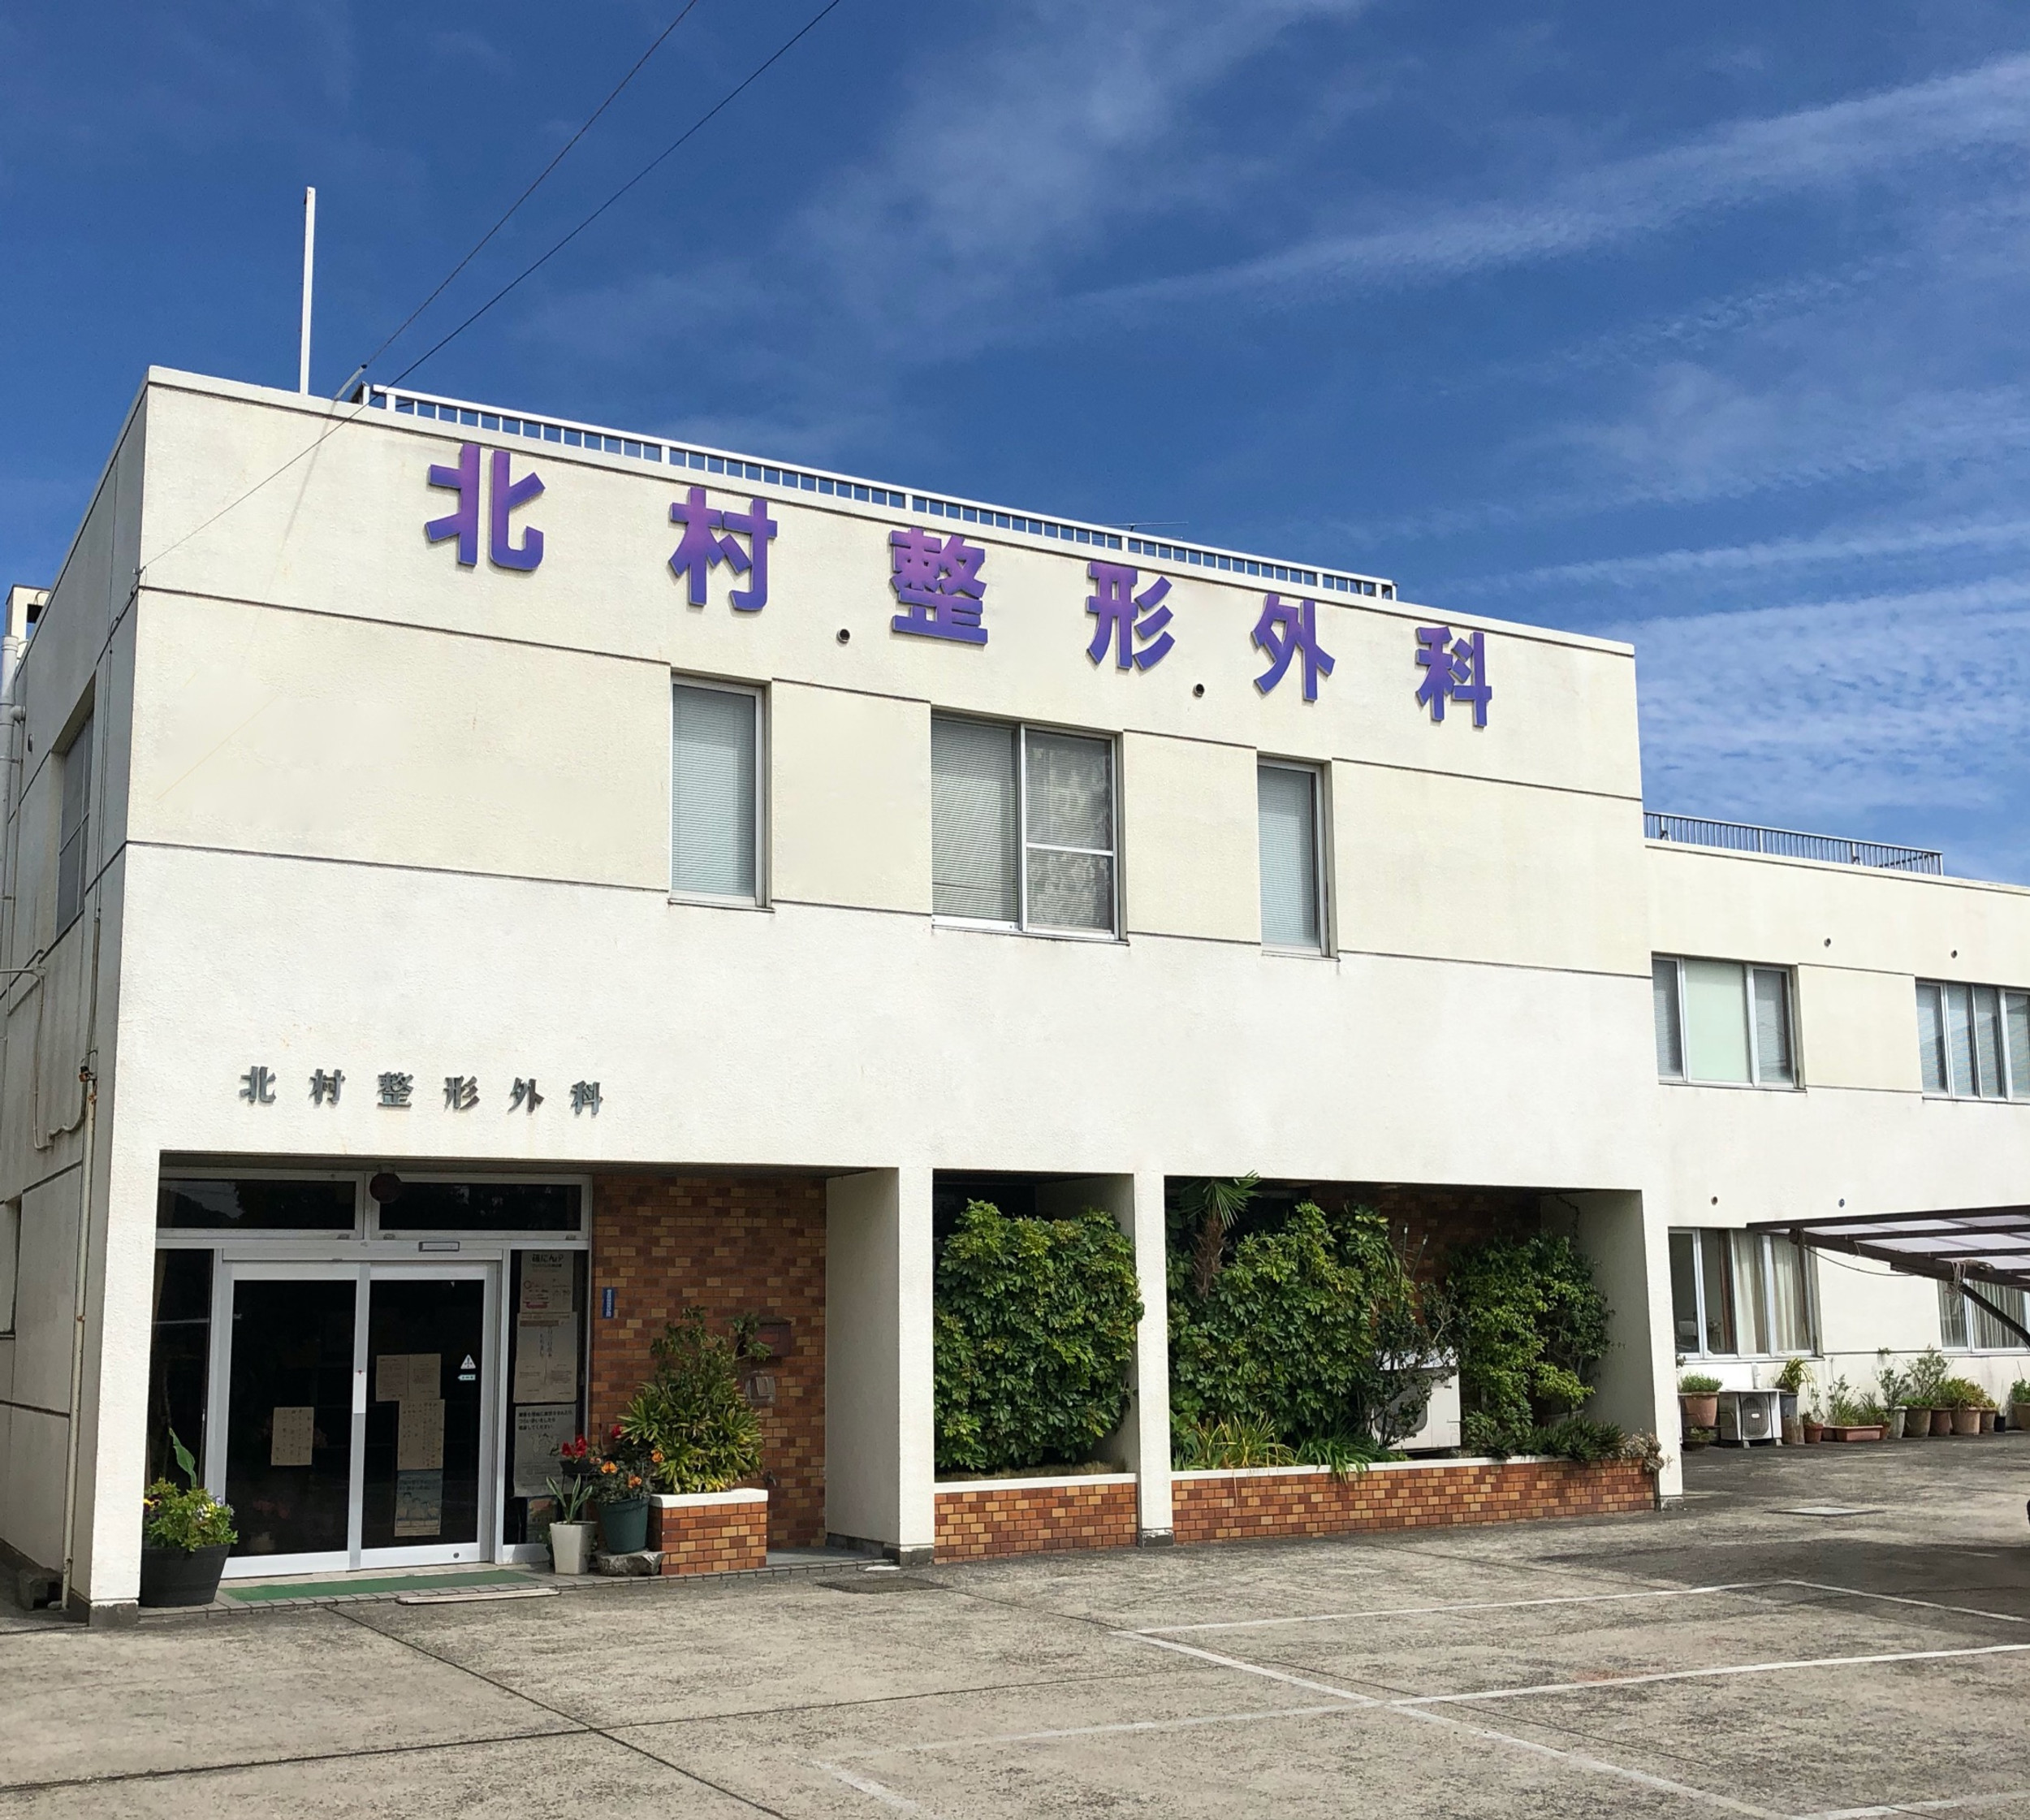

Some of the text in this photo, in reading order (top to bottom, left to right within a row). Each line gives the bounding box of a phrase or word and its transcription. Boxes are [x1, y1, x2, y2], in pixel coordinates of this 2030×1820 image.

[425, 442, 1492, 728] 北村整形外科
[239, 1066, 603, 1115] 北村整形外科
